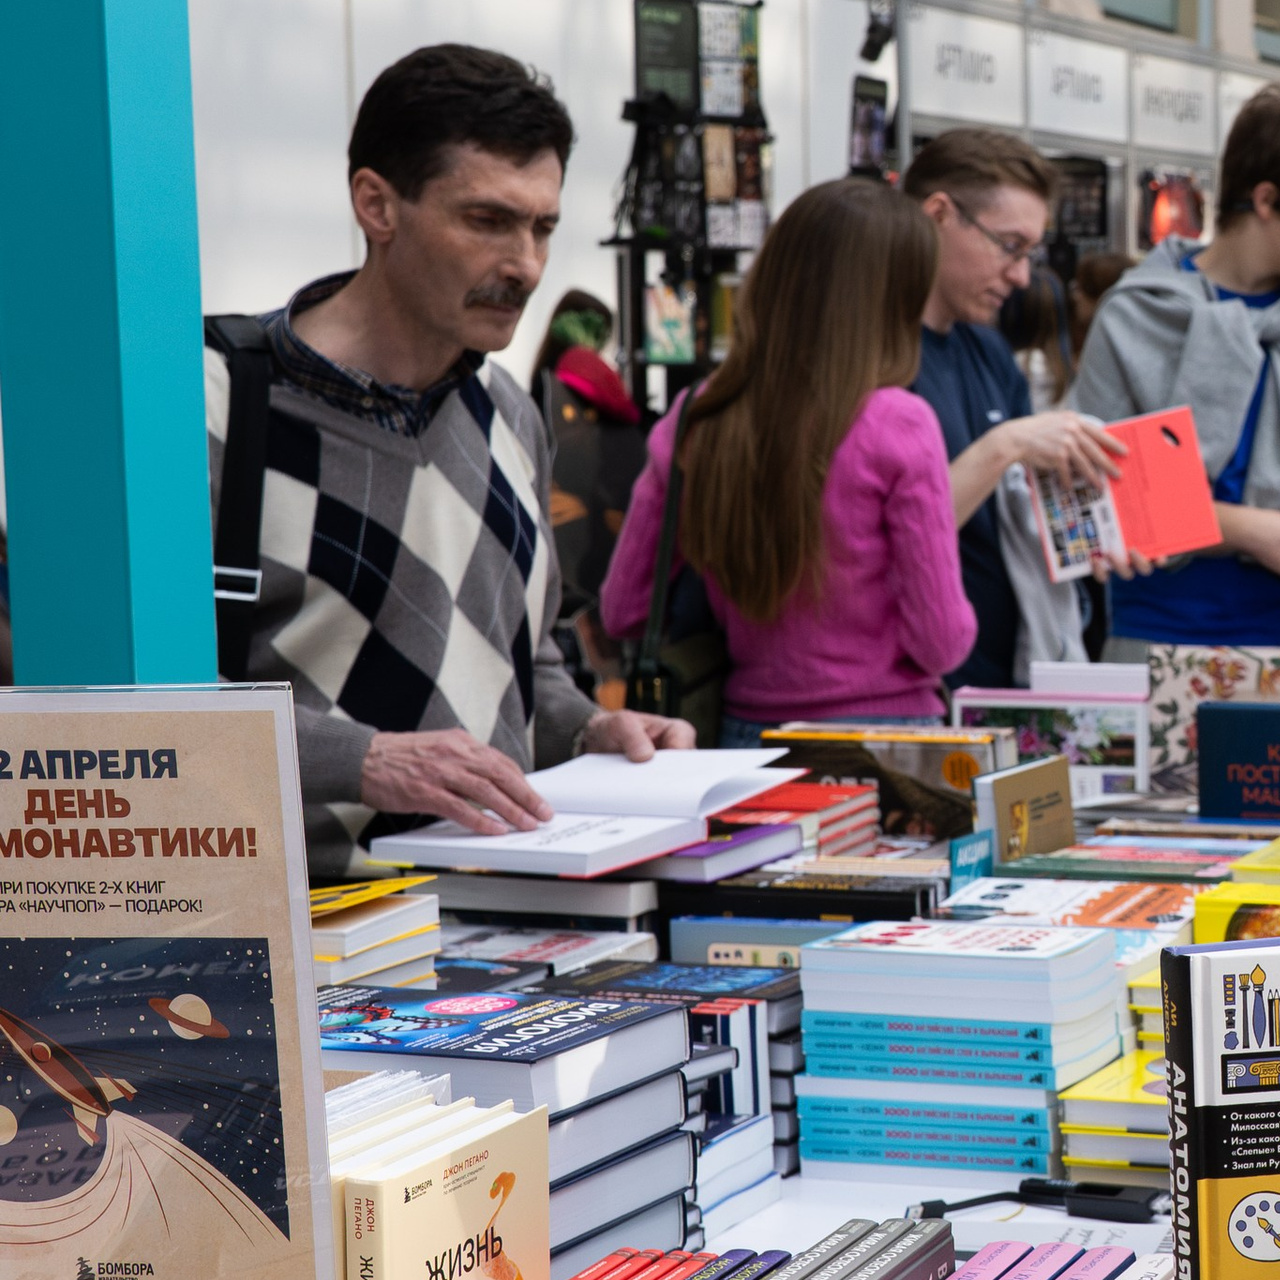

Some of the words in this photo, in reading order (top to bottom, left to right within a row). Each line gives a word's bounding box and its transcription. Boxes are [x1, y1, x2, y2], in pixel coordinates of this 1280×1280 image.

[20, 749, 178, 779] АПРЕЛЯ
[24, 789, 131, 824] ДЕНЬ
[26, 881, 96, 895] ПОКУПКЕ
[126, 881, 166, 895] КНИГ
[18, 899, 106, 913] «НАУЧПОП»
[125, 898, 203, 914] ПОДАРОК!
[464, 1002, 622, 1055] БИОЛОГИЯ
[1230, 1112, 1243, 1121] От
[1244, 1111, 1276, 1120] какого
[1230, 1136, 1257, 1146] Из-за
[1231, 1146, 1275, 1157] «Слепые»
[442, 1162, 465, 1180] ДЖОН
[464, 1150, 489, 1172] ПЕГАНО
[1231, 1161, 1255, 1170] Знал
[1256, 1160, 1267, 1169] ли
[354, 1197, 363, 1240] ПЕГАНО
[366, 1197, 375, 1233] ДЖОН
[97, 1261, 155, 1278] БОМБОРА
